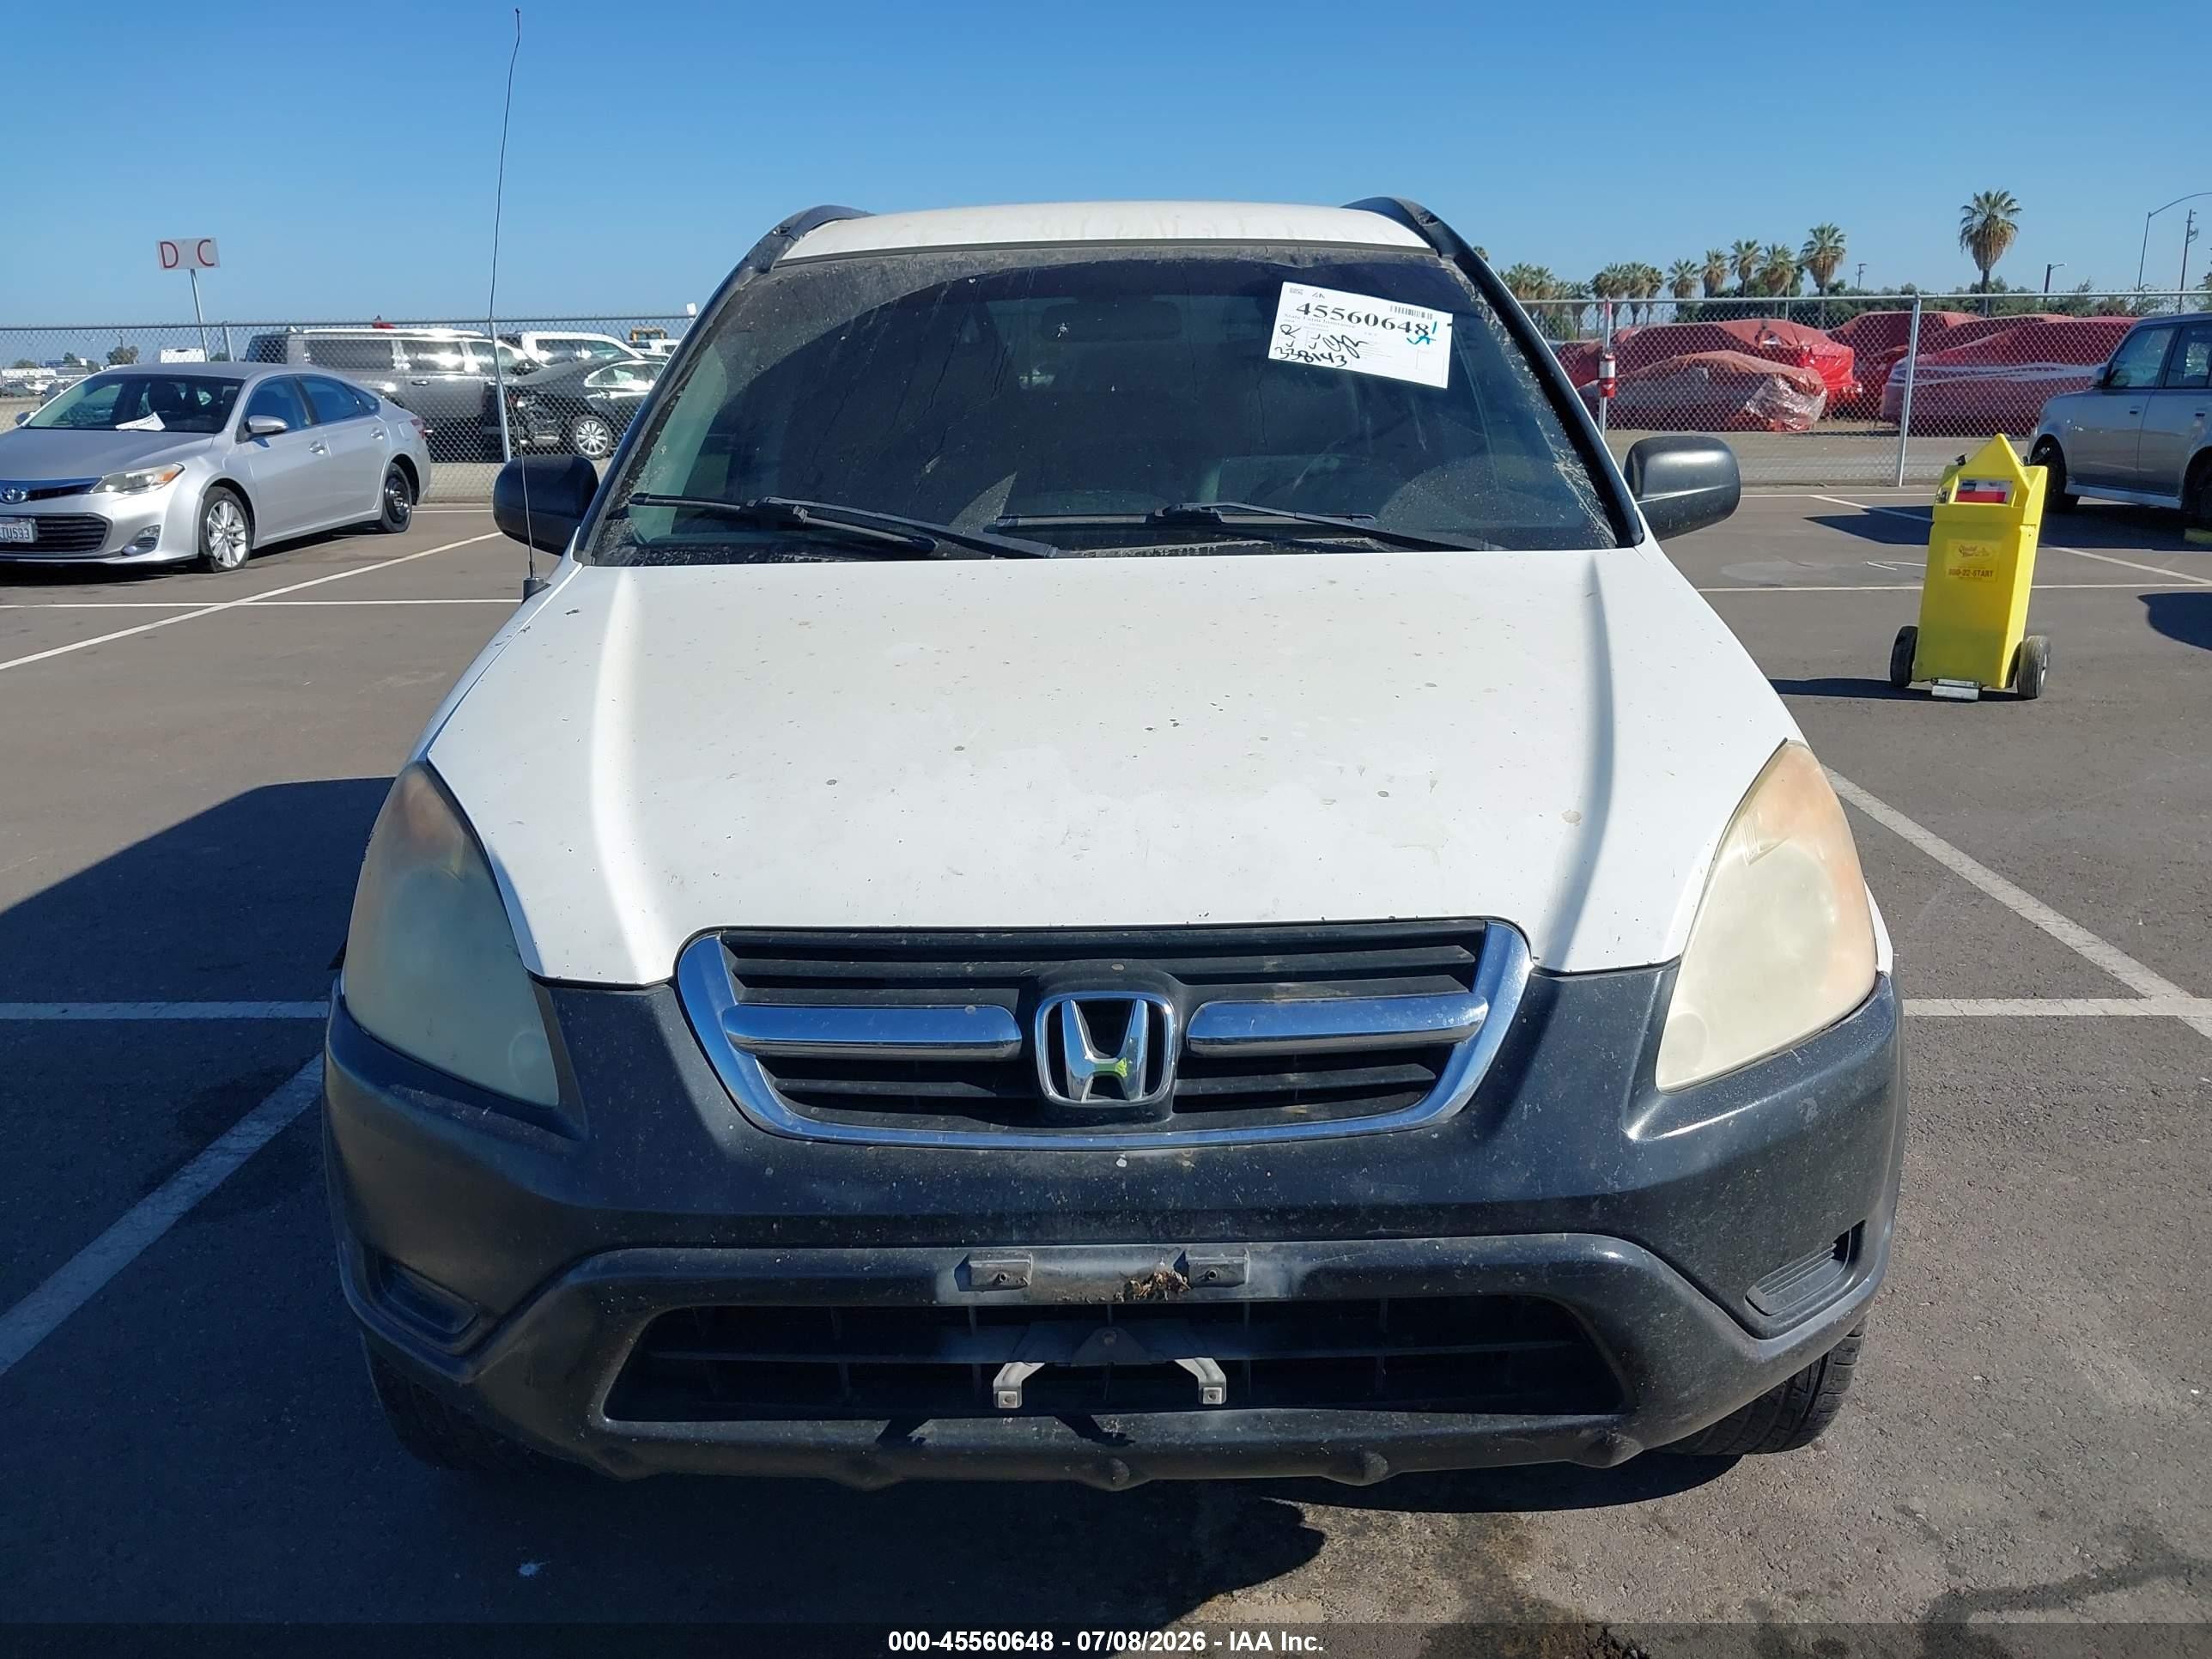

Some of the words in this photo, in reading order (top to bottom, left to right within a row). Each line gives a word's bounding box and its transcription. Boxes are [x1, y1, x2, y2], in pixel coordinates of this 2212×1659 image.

[160, 241, 179, 268] D
[198, 239, 215, 266] C
[1295, 302, 1430, 336] 45560648
